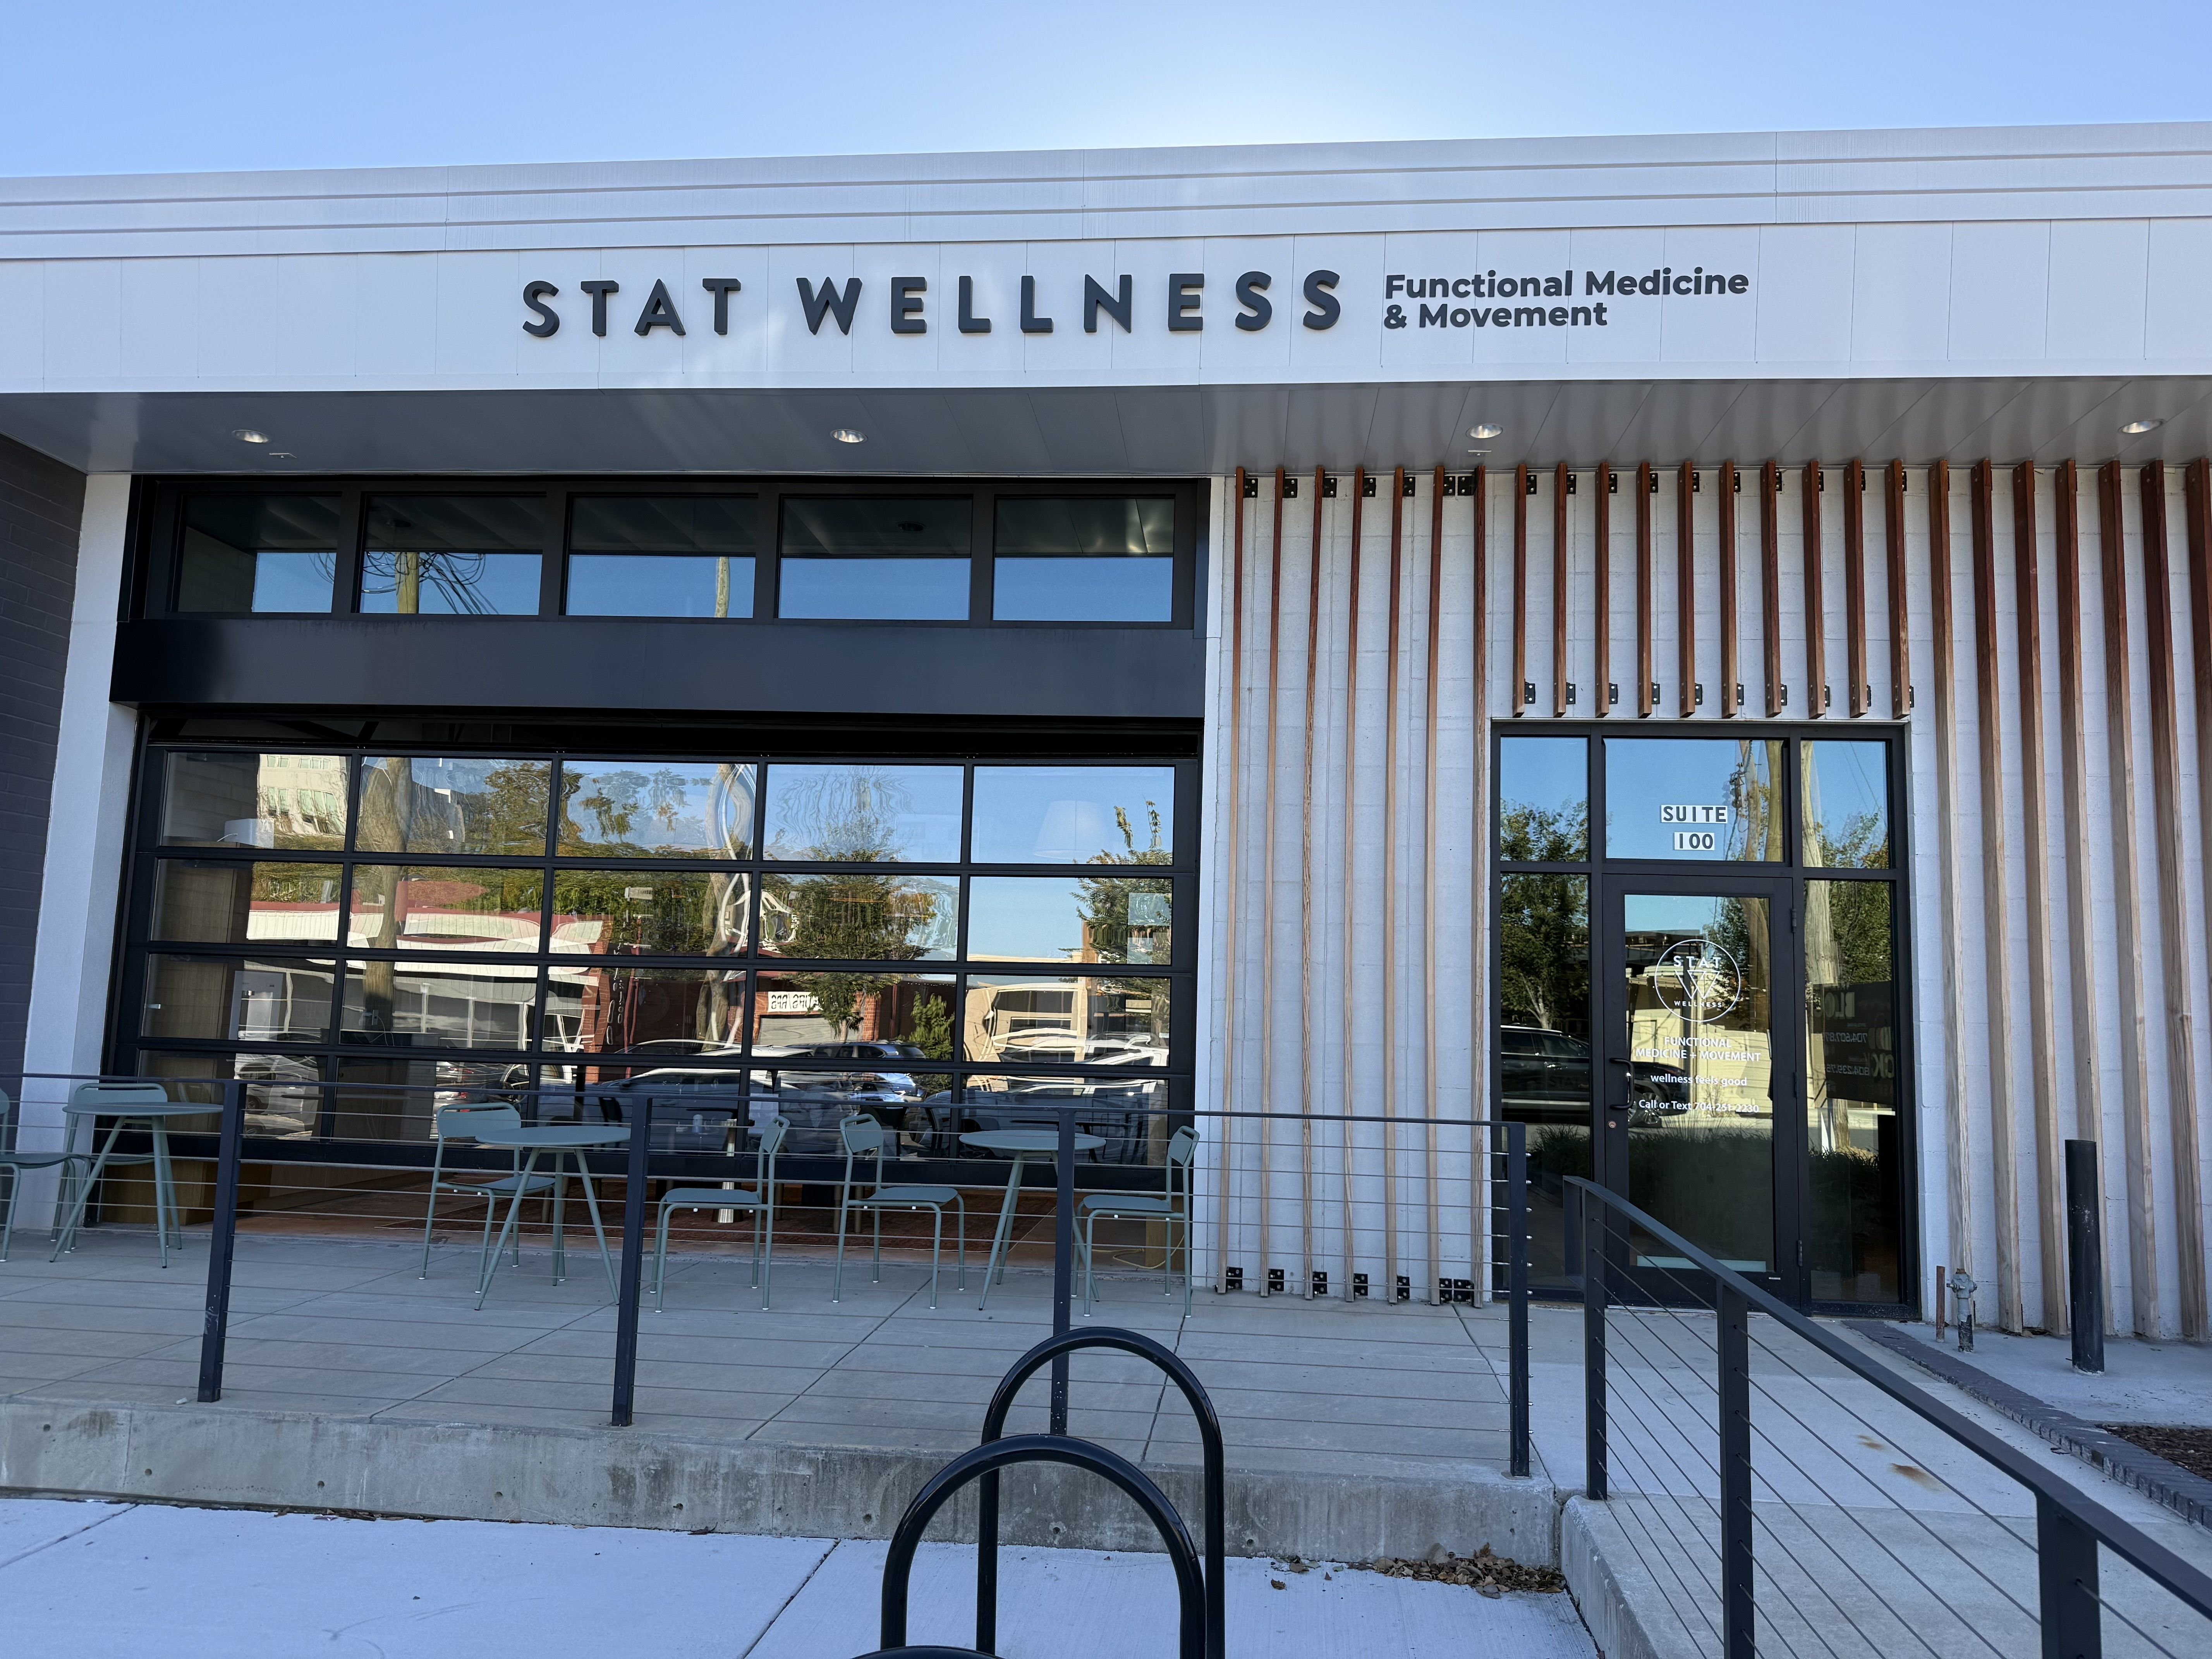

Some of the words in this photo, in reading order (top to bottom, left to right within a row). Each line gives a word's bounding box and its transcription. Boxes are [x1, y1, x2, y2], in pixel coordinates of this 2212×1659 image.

[1385, 270, 1572, 299] Functional
[1586, 267, 1748, 295] Medicine
[522, 278, 741, 338] STAT
[796, 270, 1340, 335] WELLNESS
[1384, 304, 1407, 329] &
[1419, 302, 1607, 328] Movement
[1663, 806, 1726, 822] SUITE
[1680, 833, 1713, 849] 100
[1673, 955, 1721, 968] STAT
[1664, 1037, 1731, 1048] FUNCTIONAL
[1636, 1048, 1687, 1058] MEDICINE
[1700, 1051, 1760, 1061] MOVEMENT
[1650, 1073, 1692, 1084] wellness
[1695, 1075, 1718, 1084] feels
[1721, 1077, 1747, 1086] good
[1639, 1099, 1656, 1108] Call
[1671, 1101, 1692, 1109] Text
[1694, 1102, 1759, 1113] 704-251-2230
